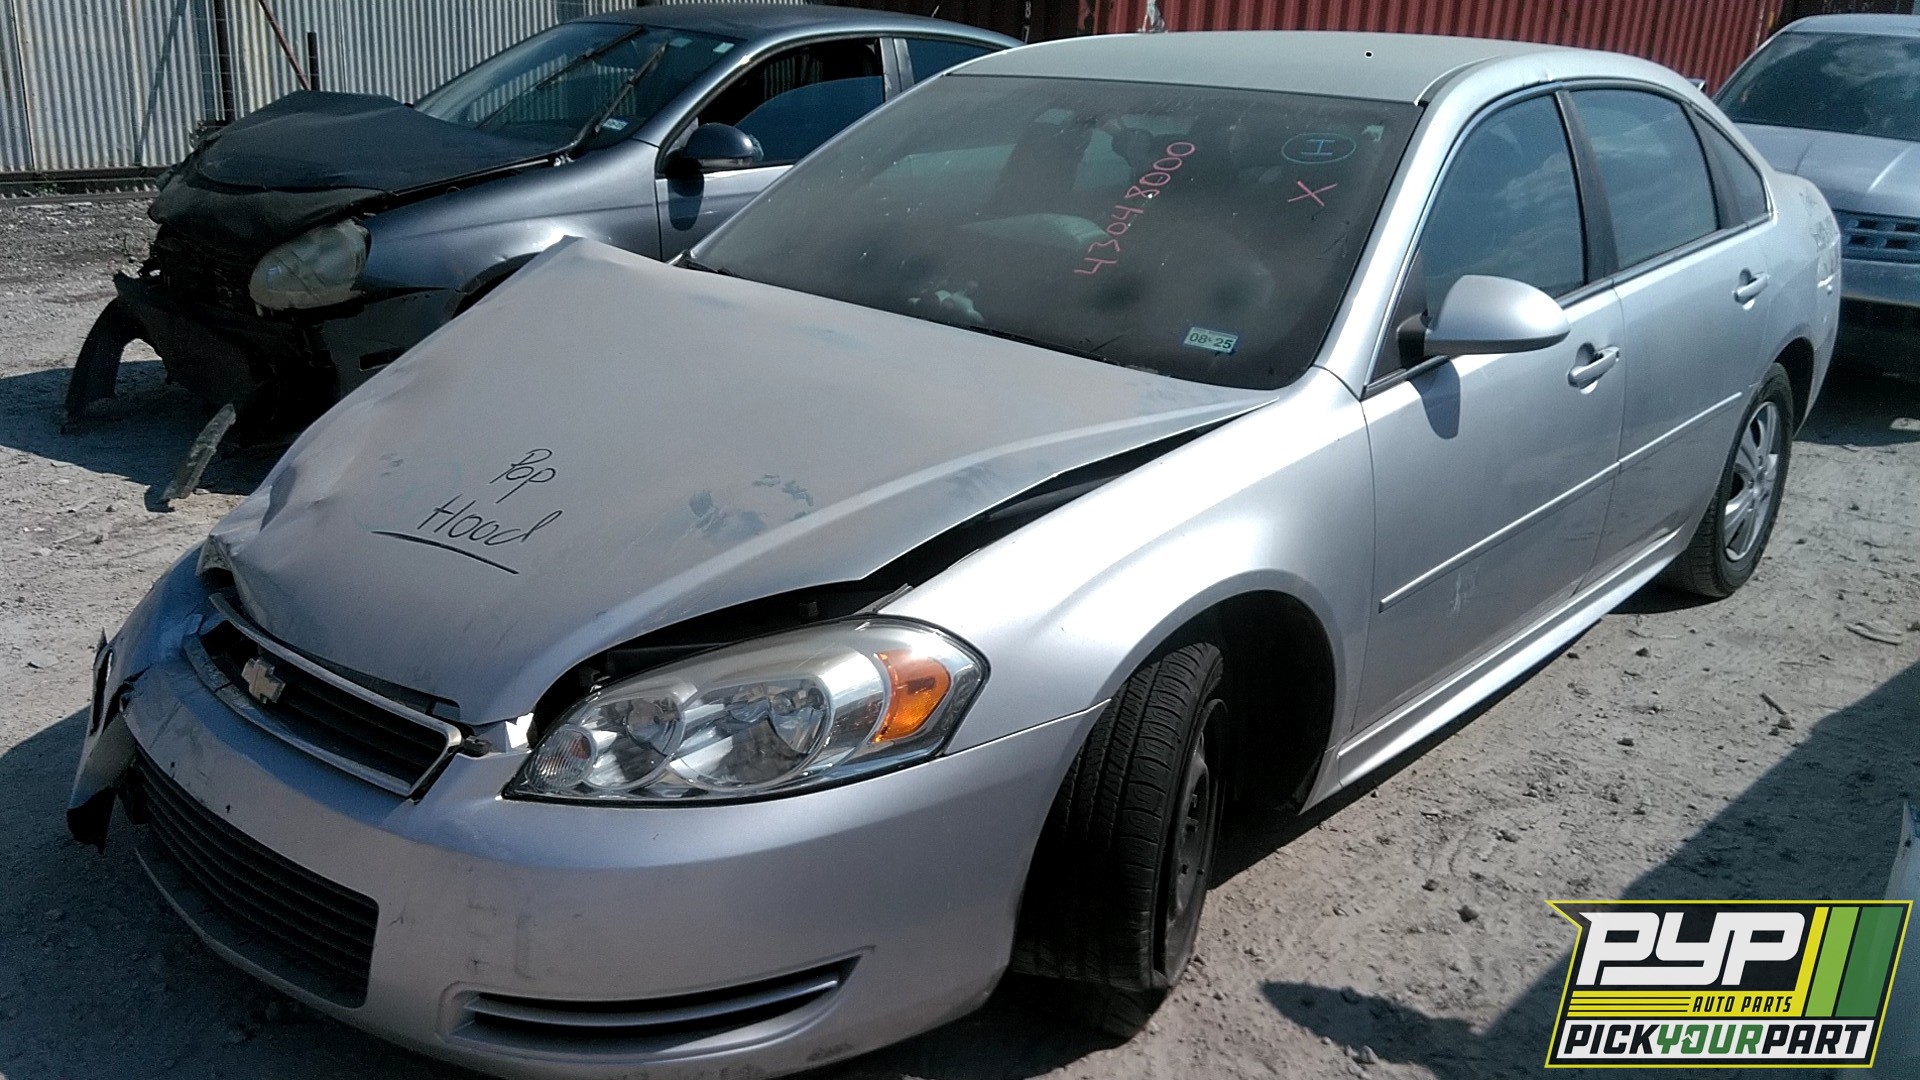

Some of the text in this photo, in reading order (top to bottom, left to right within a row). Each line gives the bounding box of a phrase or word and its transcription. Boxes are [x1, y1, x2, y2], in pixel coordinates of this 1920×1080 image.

[1213, 337, 1234, 349] 25
[489, 448, 557, 504] Pop
[416, 493, 563, 546] Hood
